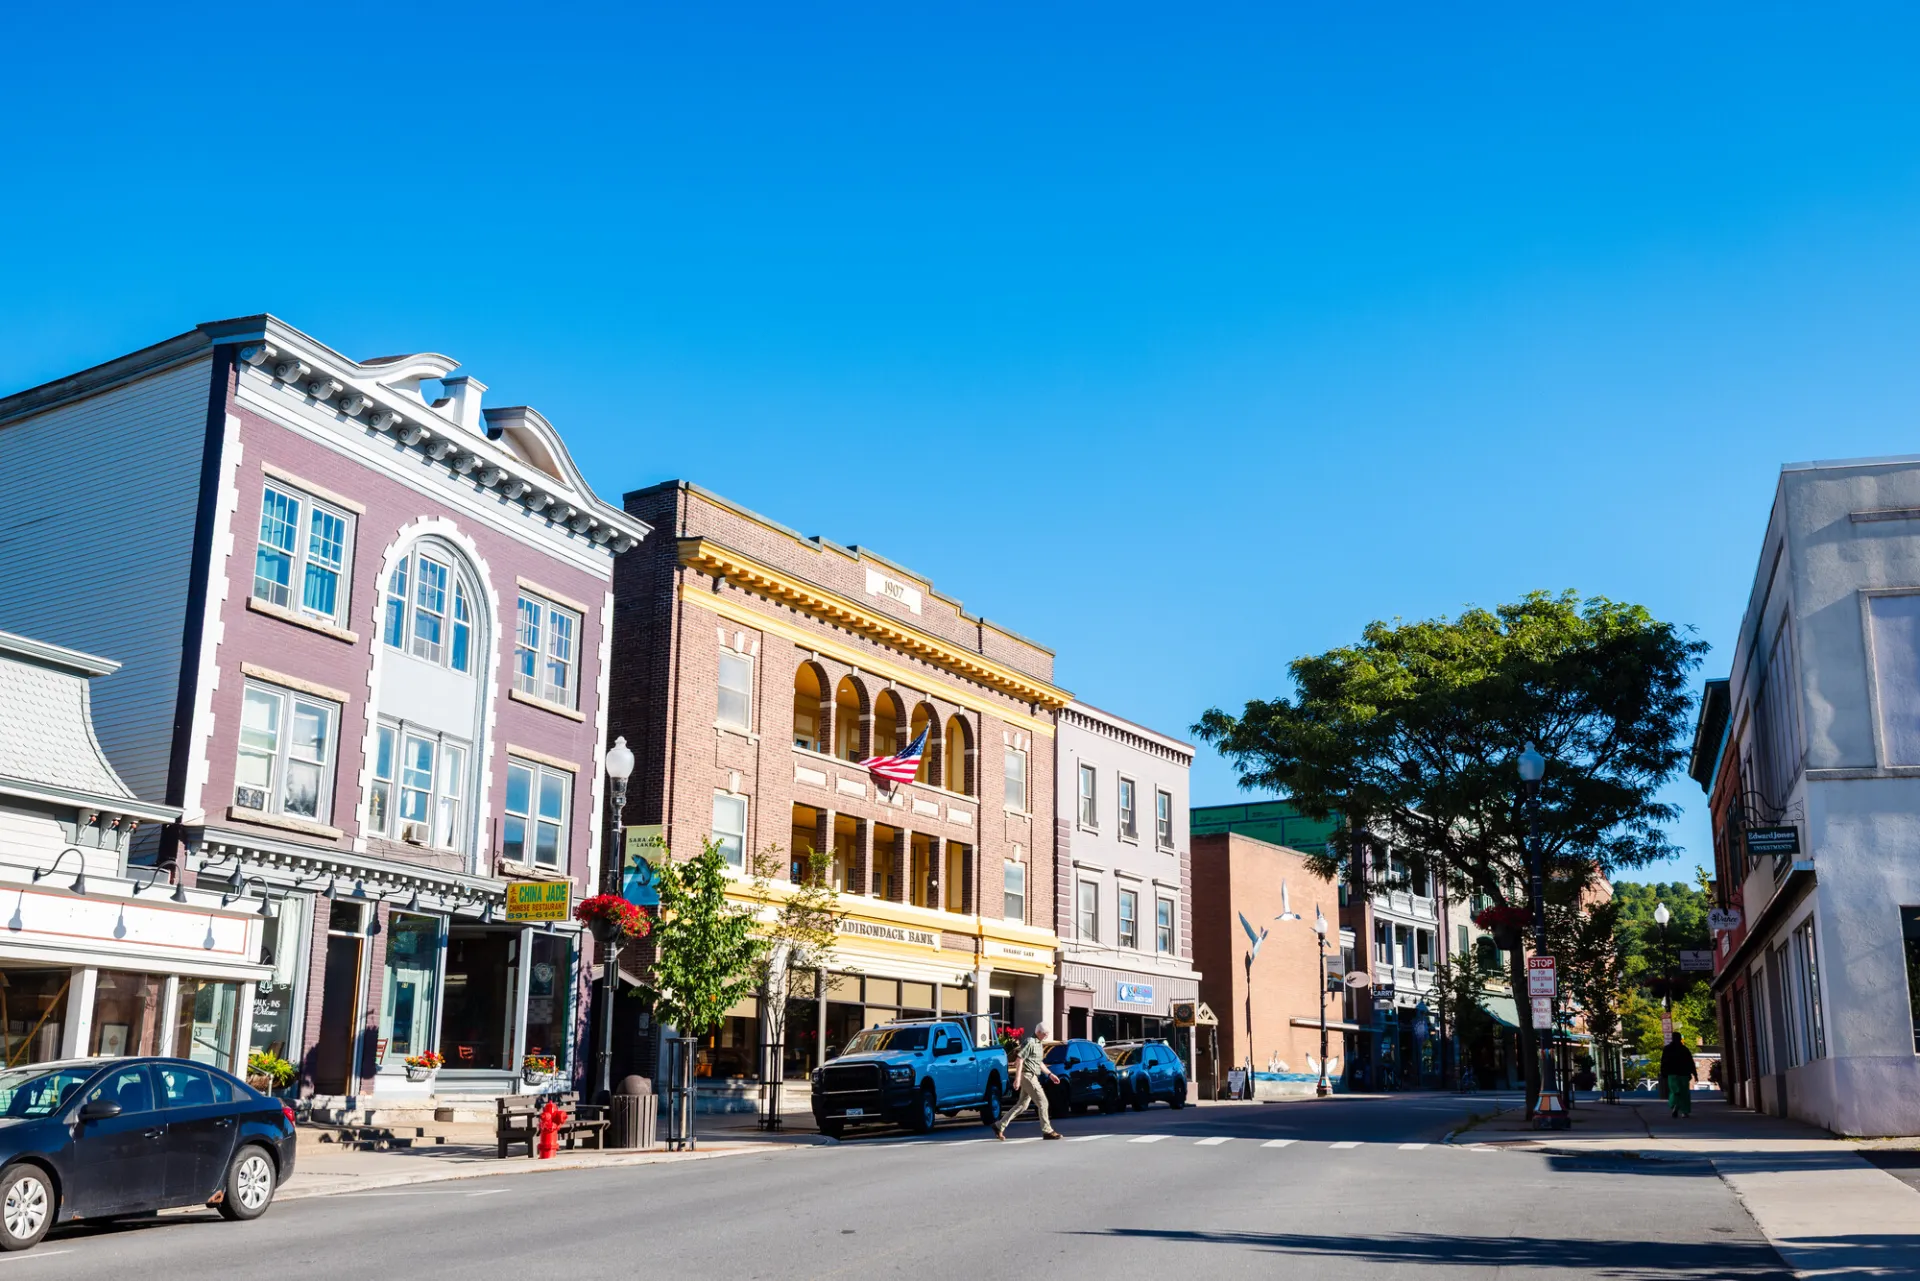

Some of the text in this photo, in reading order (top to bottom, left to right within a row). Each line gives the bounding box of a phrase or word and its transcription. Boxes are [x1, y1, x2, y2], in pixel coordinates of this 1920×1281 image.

[885, 580, 904, 599] 1907
[519, 885, 542, 903] CHINA
[546, 884, 566, 902] JADE
[510, 903, 565, 912] CHINESE RESTAURANT
[508, 911, 564, 919] 891-6145
[841, 918, 934, 946] ADIRONDACK BANK
[1530, 959, 1553, 968] STOP
